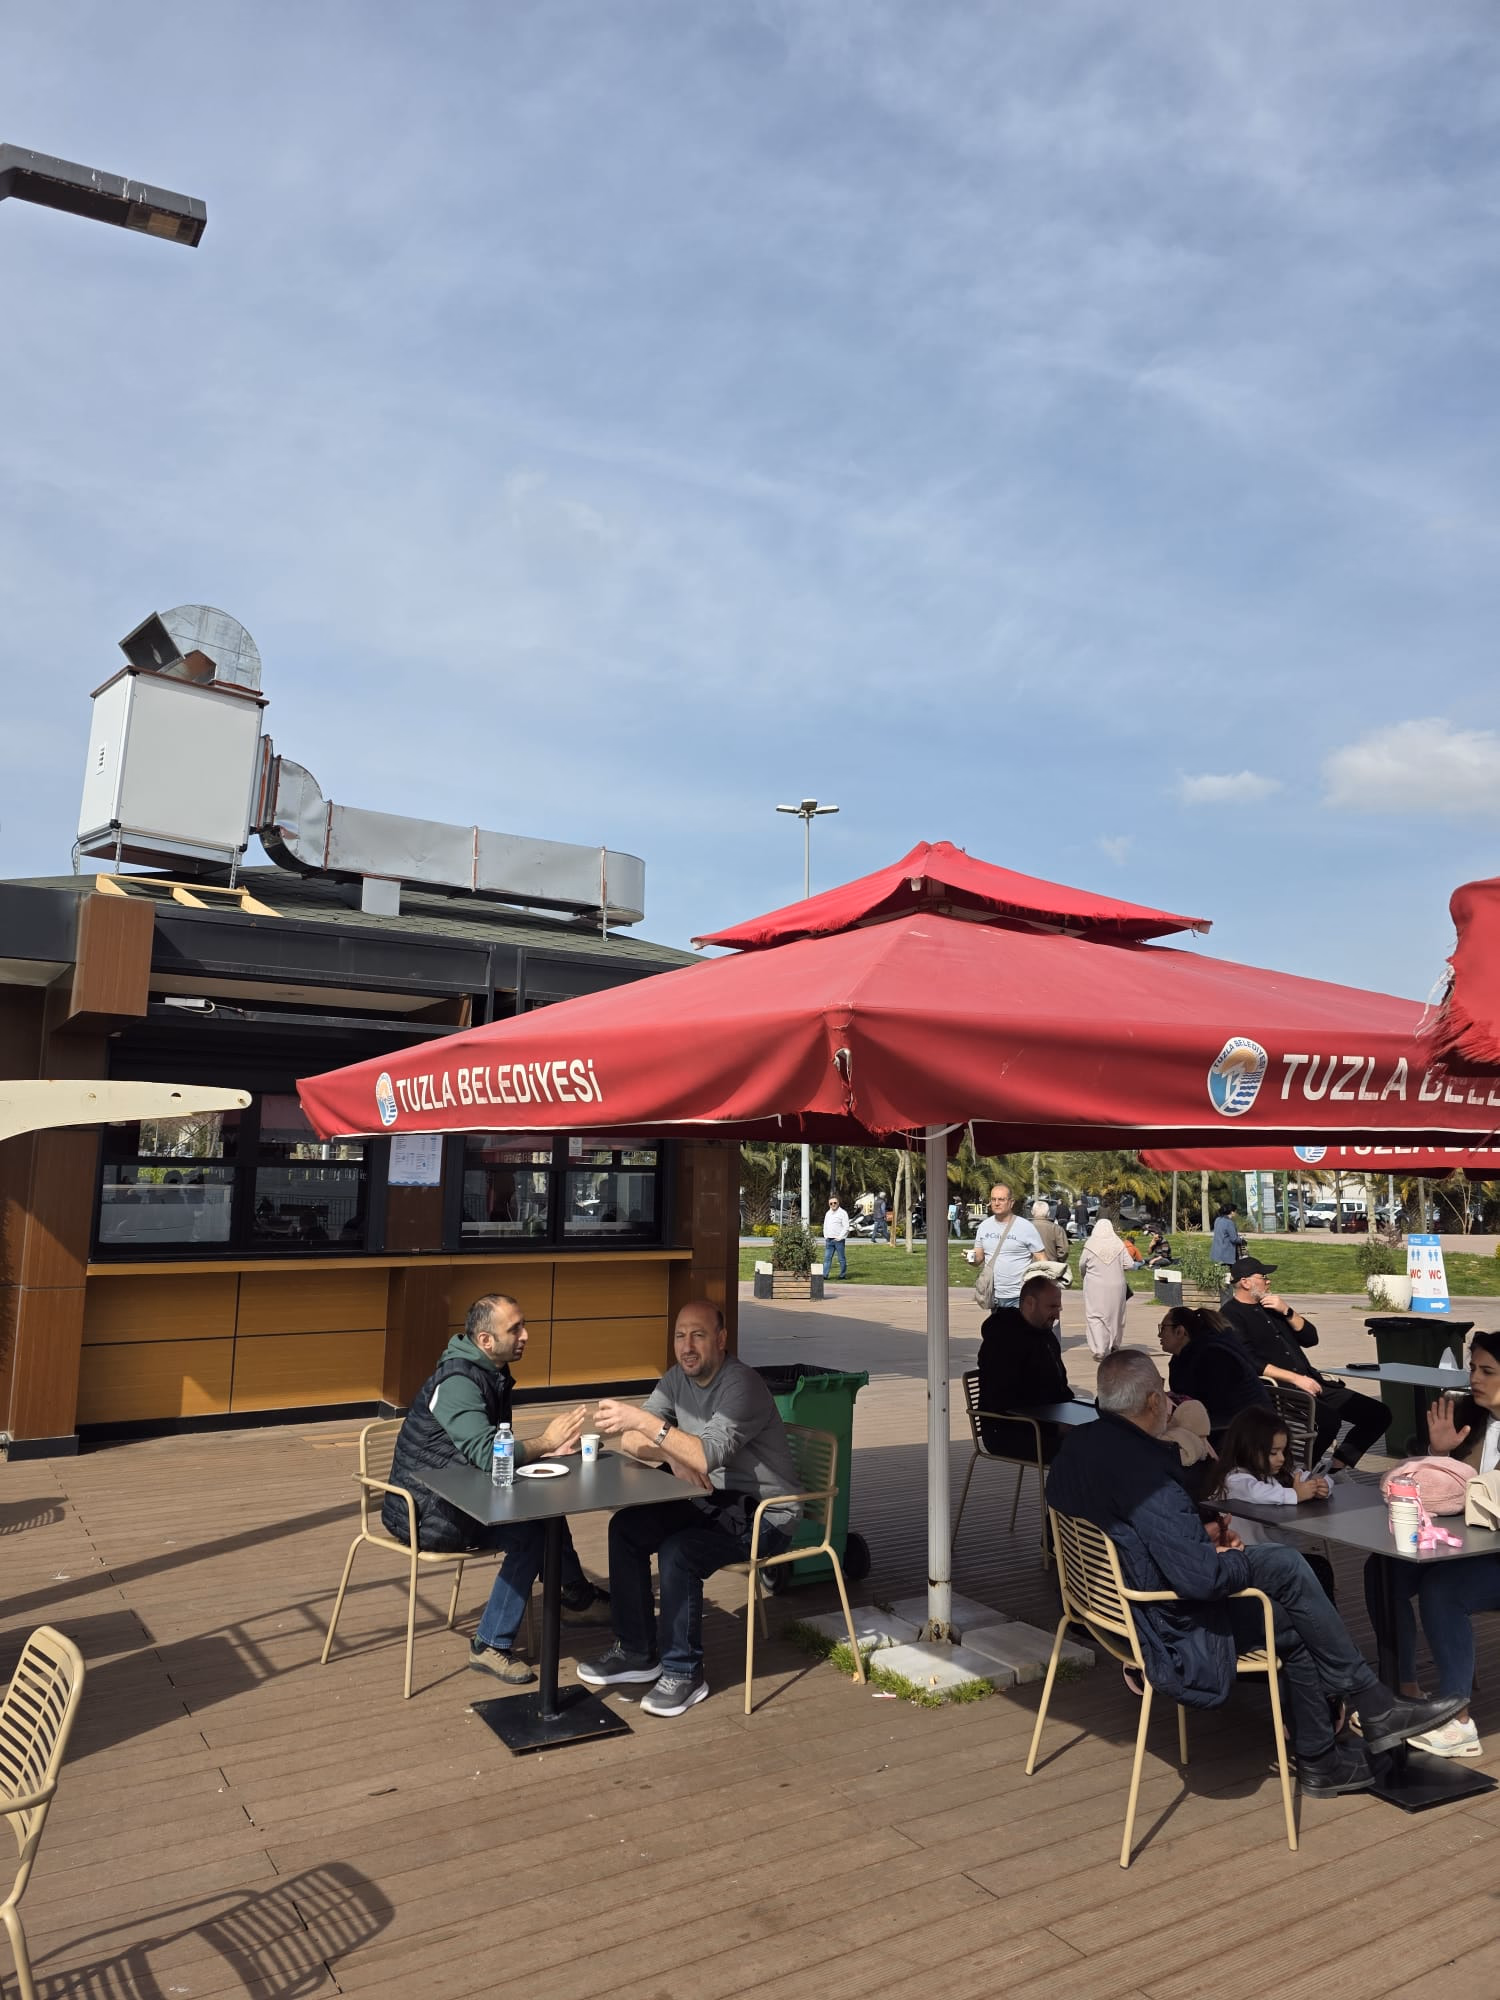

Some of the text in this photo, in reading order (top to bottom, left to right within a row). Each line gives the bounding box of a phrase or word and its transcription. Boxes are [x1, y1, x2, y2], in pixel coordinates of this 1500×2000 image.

[396, 1072, 457, 1113] TUZLA
[458, 1059, 602, 1105] BELEDİYESİ
[1280, 1053, 1408, 1101] TUZLA
[1410, 1268, 1442, 1280] WC WC
